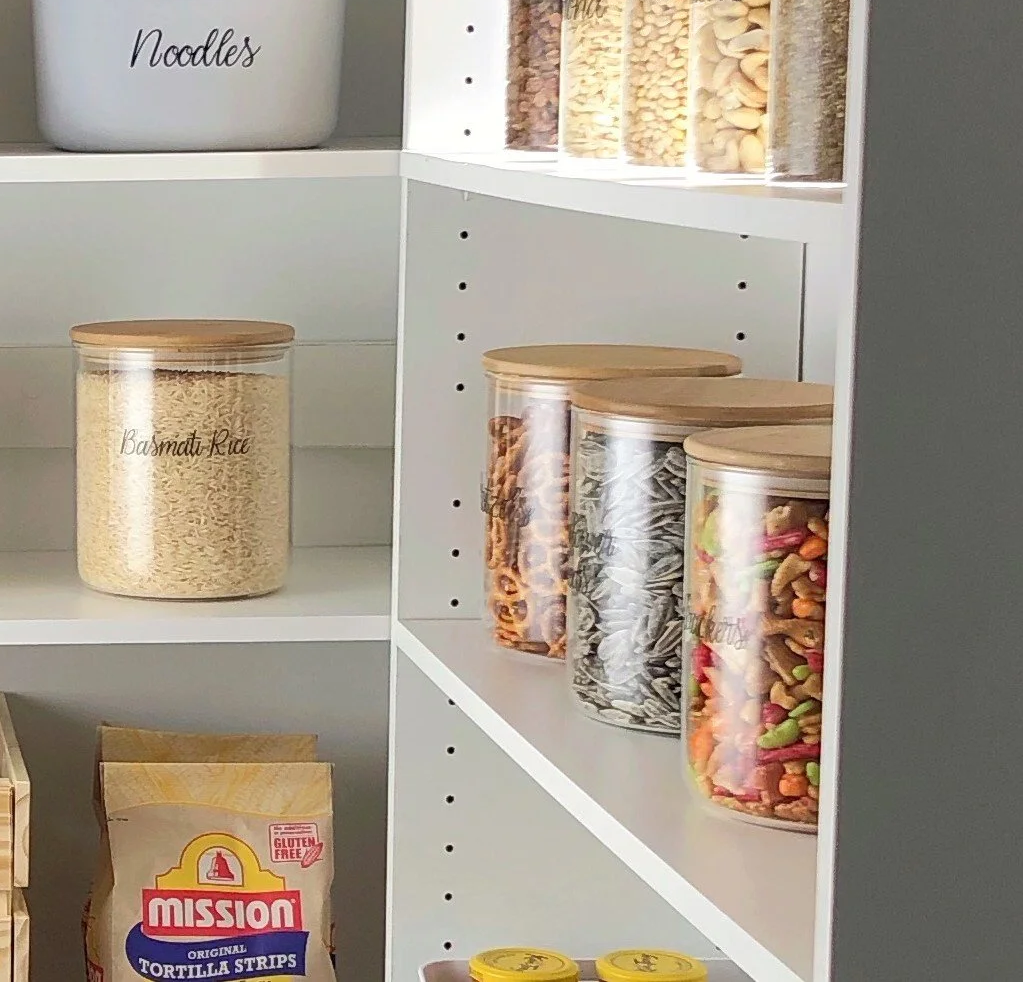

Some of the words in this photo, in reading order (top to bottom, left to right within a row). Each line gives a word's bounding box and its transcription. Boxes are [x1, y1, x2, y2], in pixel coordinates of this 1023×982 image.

[130, 28, 261, 68] Noodles
[120, 428, 204, 457] Basmati
[205, 428, 253, 458] Rice
[274, 837, 316, 849] GLUTEN
[274, 848, 302, 860] FREE
[148, 897, 295, 930] MISSION
[187, 944, 248, 960] ORIGINAL
[138, 957, 230, 980] TORTILLA
[234, 954, 297, 974] STRIPS
